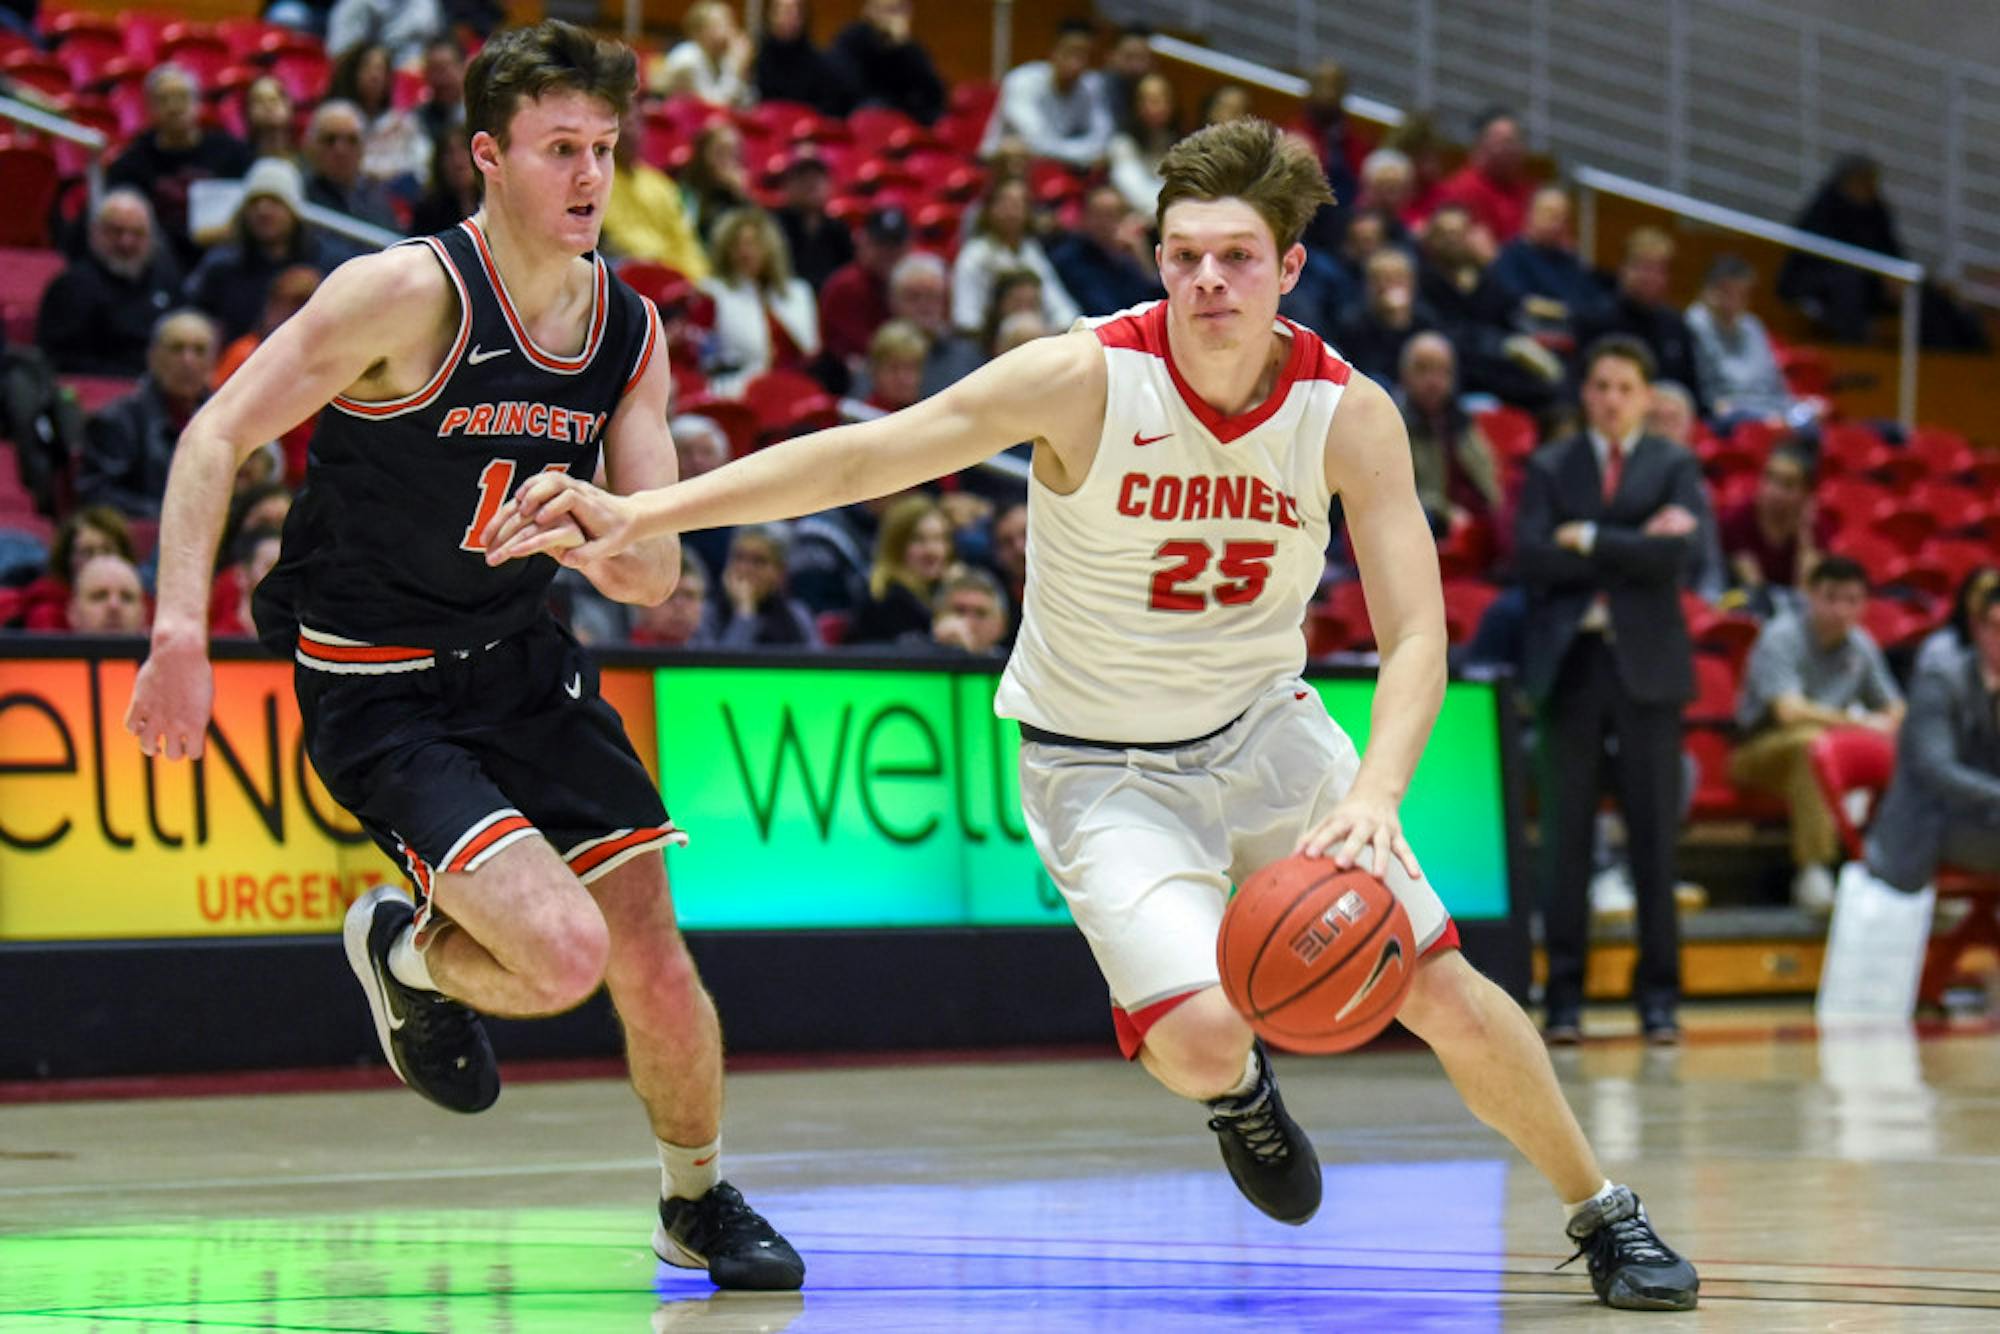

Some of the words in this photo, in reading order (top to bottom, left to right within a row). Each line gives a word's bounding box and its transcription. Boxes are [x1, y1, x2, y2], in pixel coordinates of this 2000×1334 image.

[460, 458, 571, 552] 1
[1147, 538, 1278, 612] 25
[1291, 889, 1370, 967] ELITE
